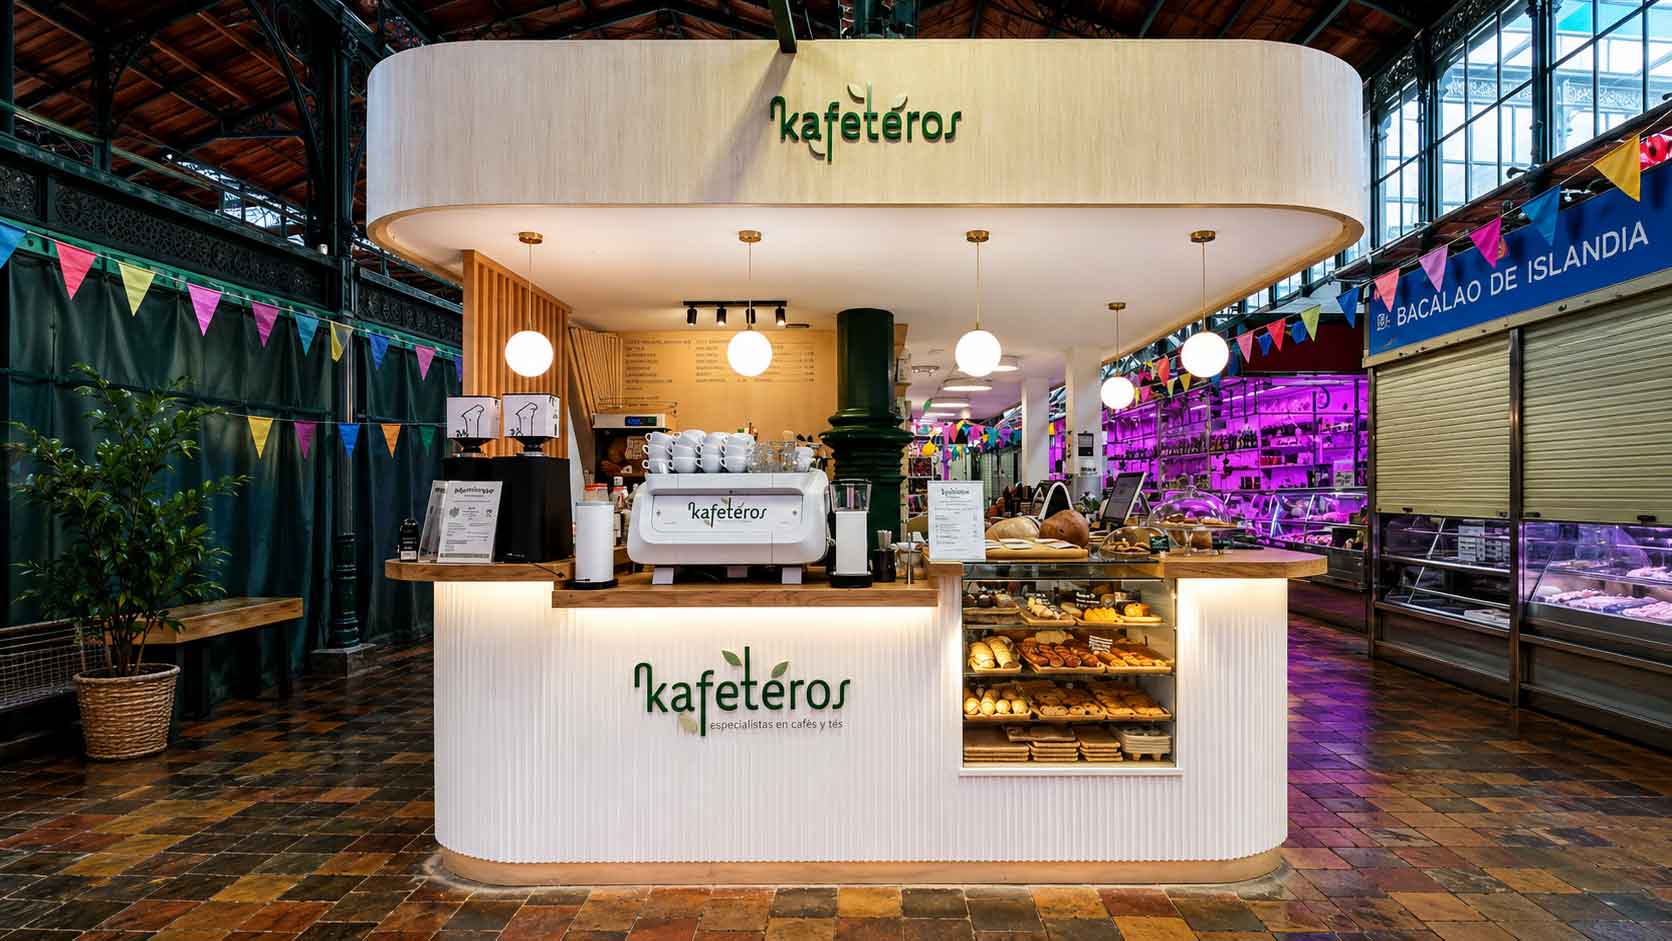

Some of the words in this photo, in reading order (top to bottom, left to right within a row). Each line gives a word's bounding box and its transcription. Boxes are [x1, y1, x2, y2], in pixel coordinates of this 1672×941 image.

[1397, 280, 1481, 327] BACALAO
[1490, 265, 1518, 296] DE
[1528, 221, 1649, 283] ISLANDIA
[710, 719, 774, 732] especialistas
[776, 721, 788, 729] en
[819, 721, 826, 733] y
[828, 719, 843, 729] tés
